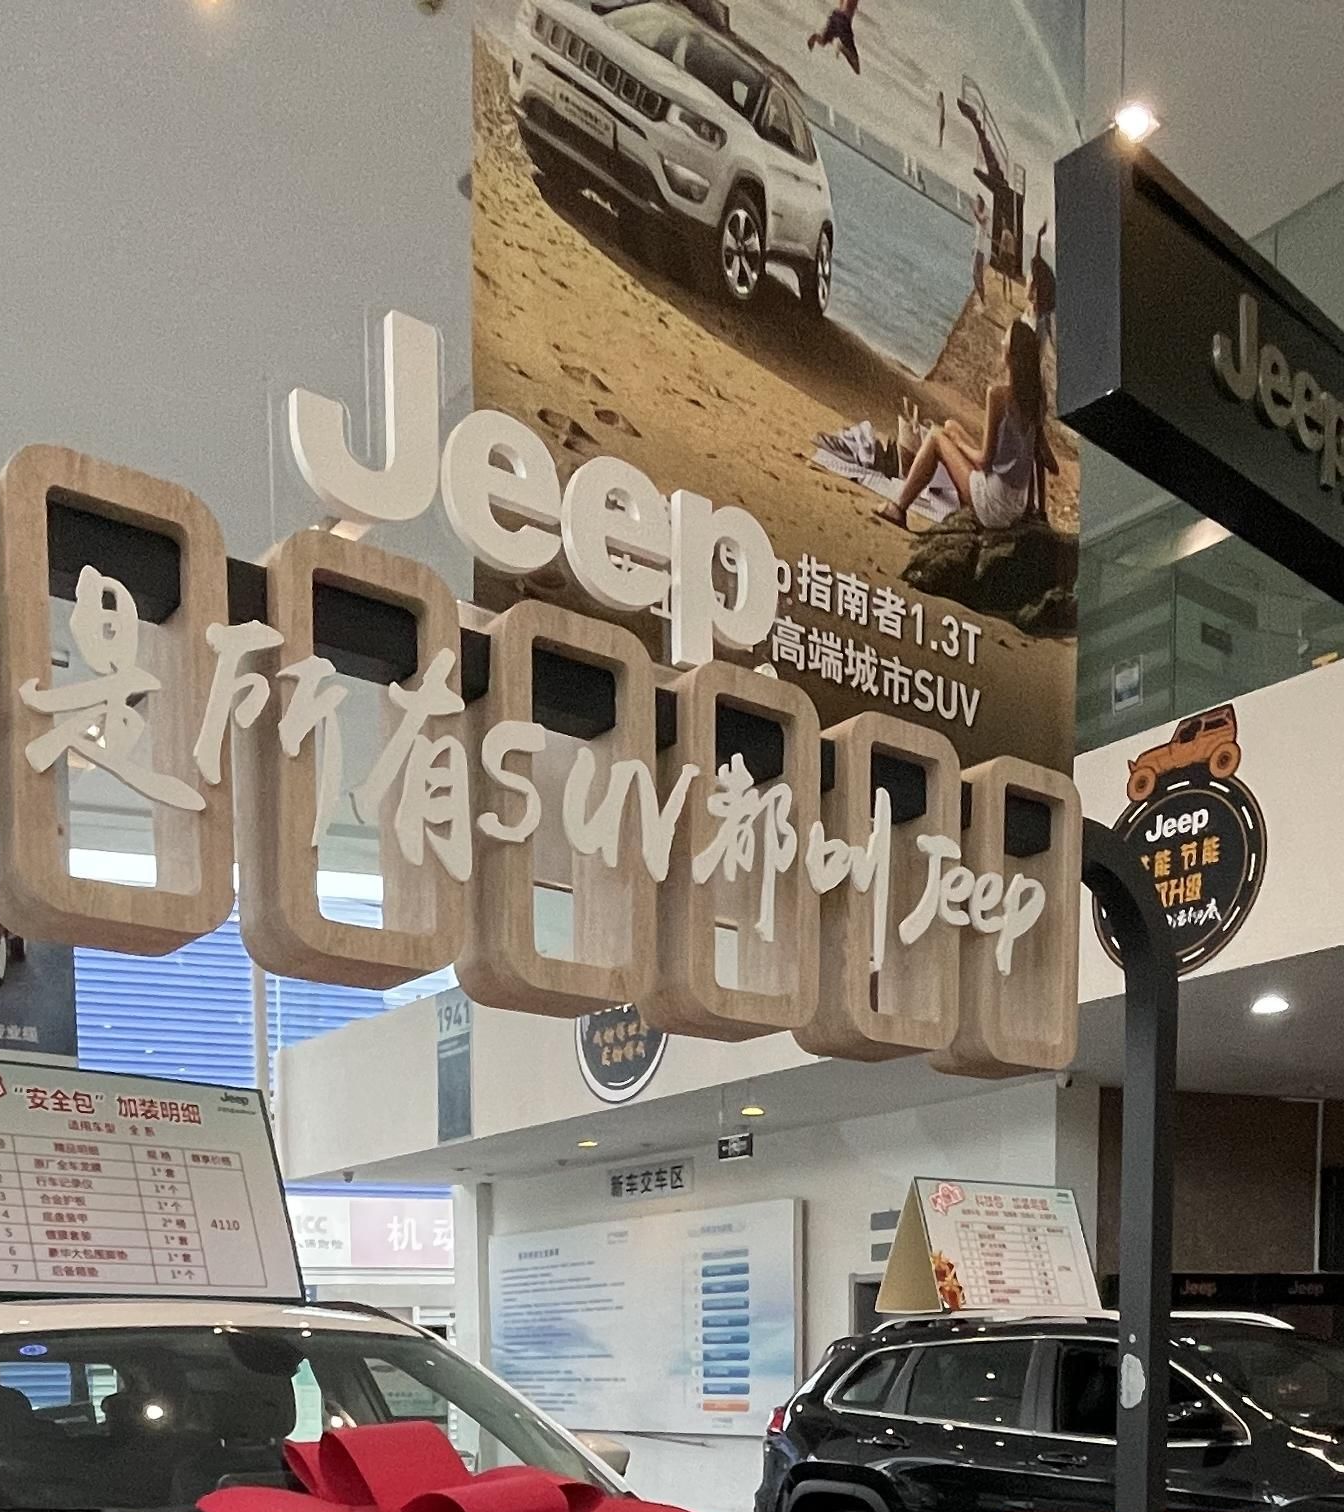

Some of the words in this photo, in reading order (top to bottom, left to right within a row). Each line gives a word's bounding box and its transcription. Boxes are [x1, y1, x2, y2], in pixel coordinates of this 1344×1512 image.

[288, 309, 779, 669] Jeep
[771, 614, 983, 728] 高端城市SUV
[1145, 808, 1209, 842] Jeep
[437, 999, 471, 1035] 1941
[116, 1096, 202, 1126] 加装明细
[210, 1218, 241, 1232] 4110
